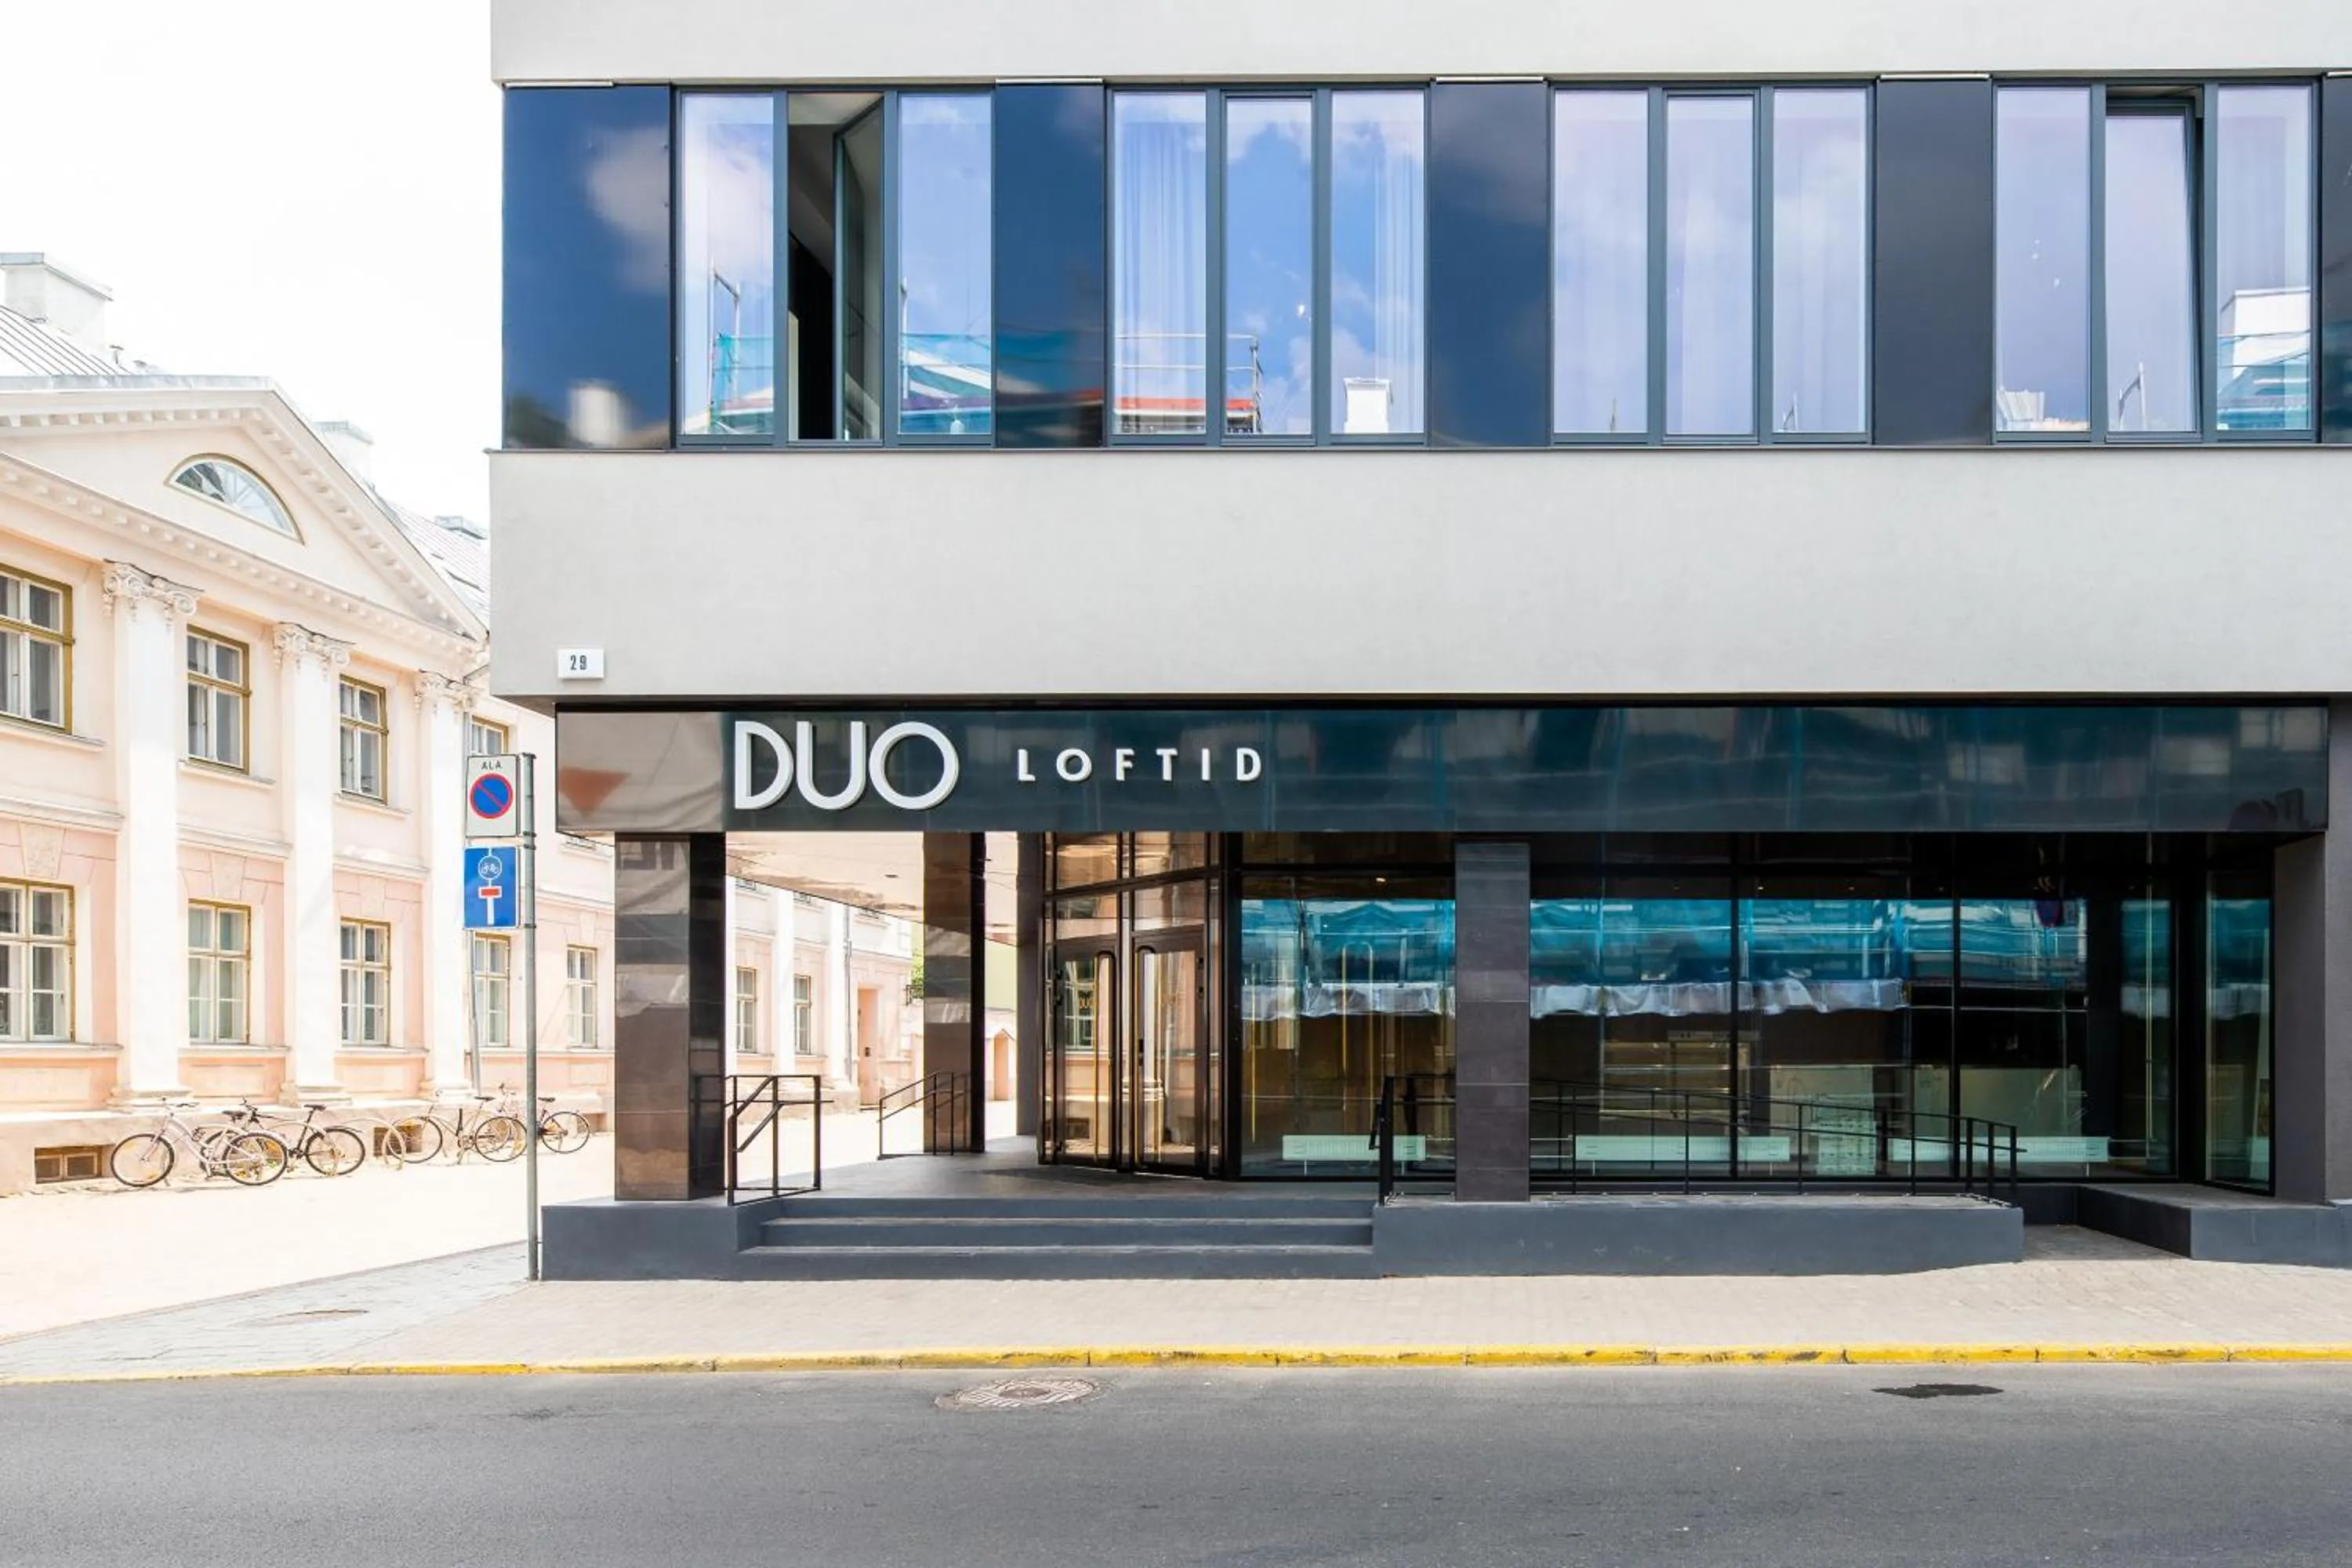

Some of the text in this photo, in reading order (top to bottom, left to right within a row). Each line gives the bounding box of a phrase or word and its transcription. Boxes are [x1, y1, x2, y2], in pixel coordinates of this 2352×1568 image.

[570, 654, 587, 670] 29
[481, 760, 503, 771] ALA
[734, 720, 1262, 810] DUO LOFTID
